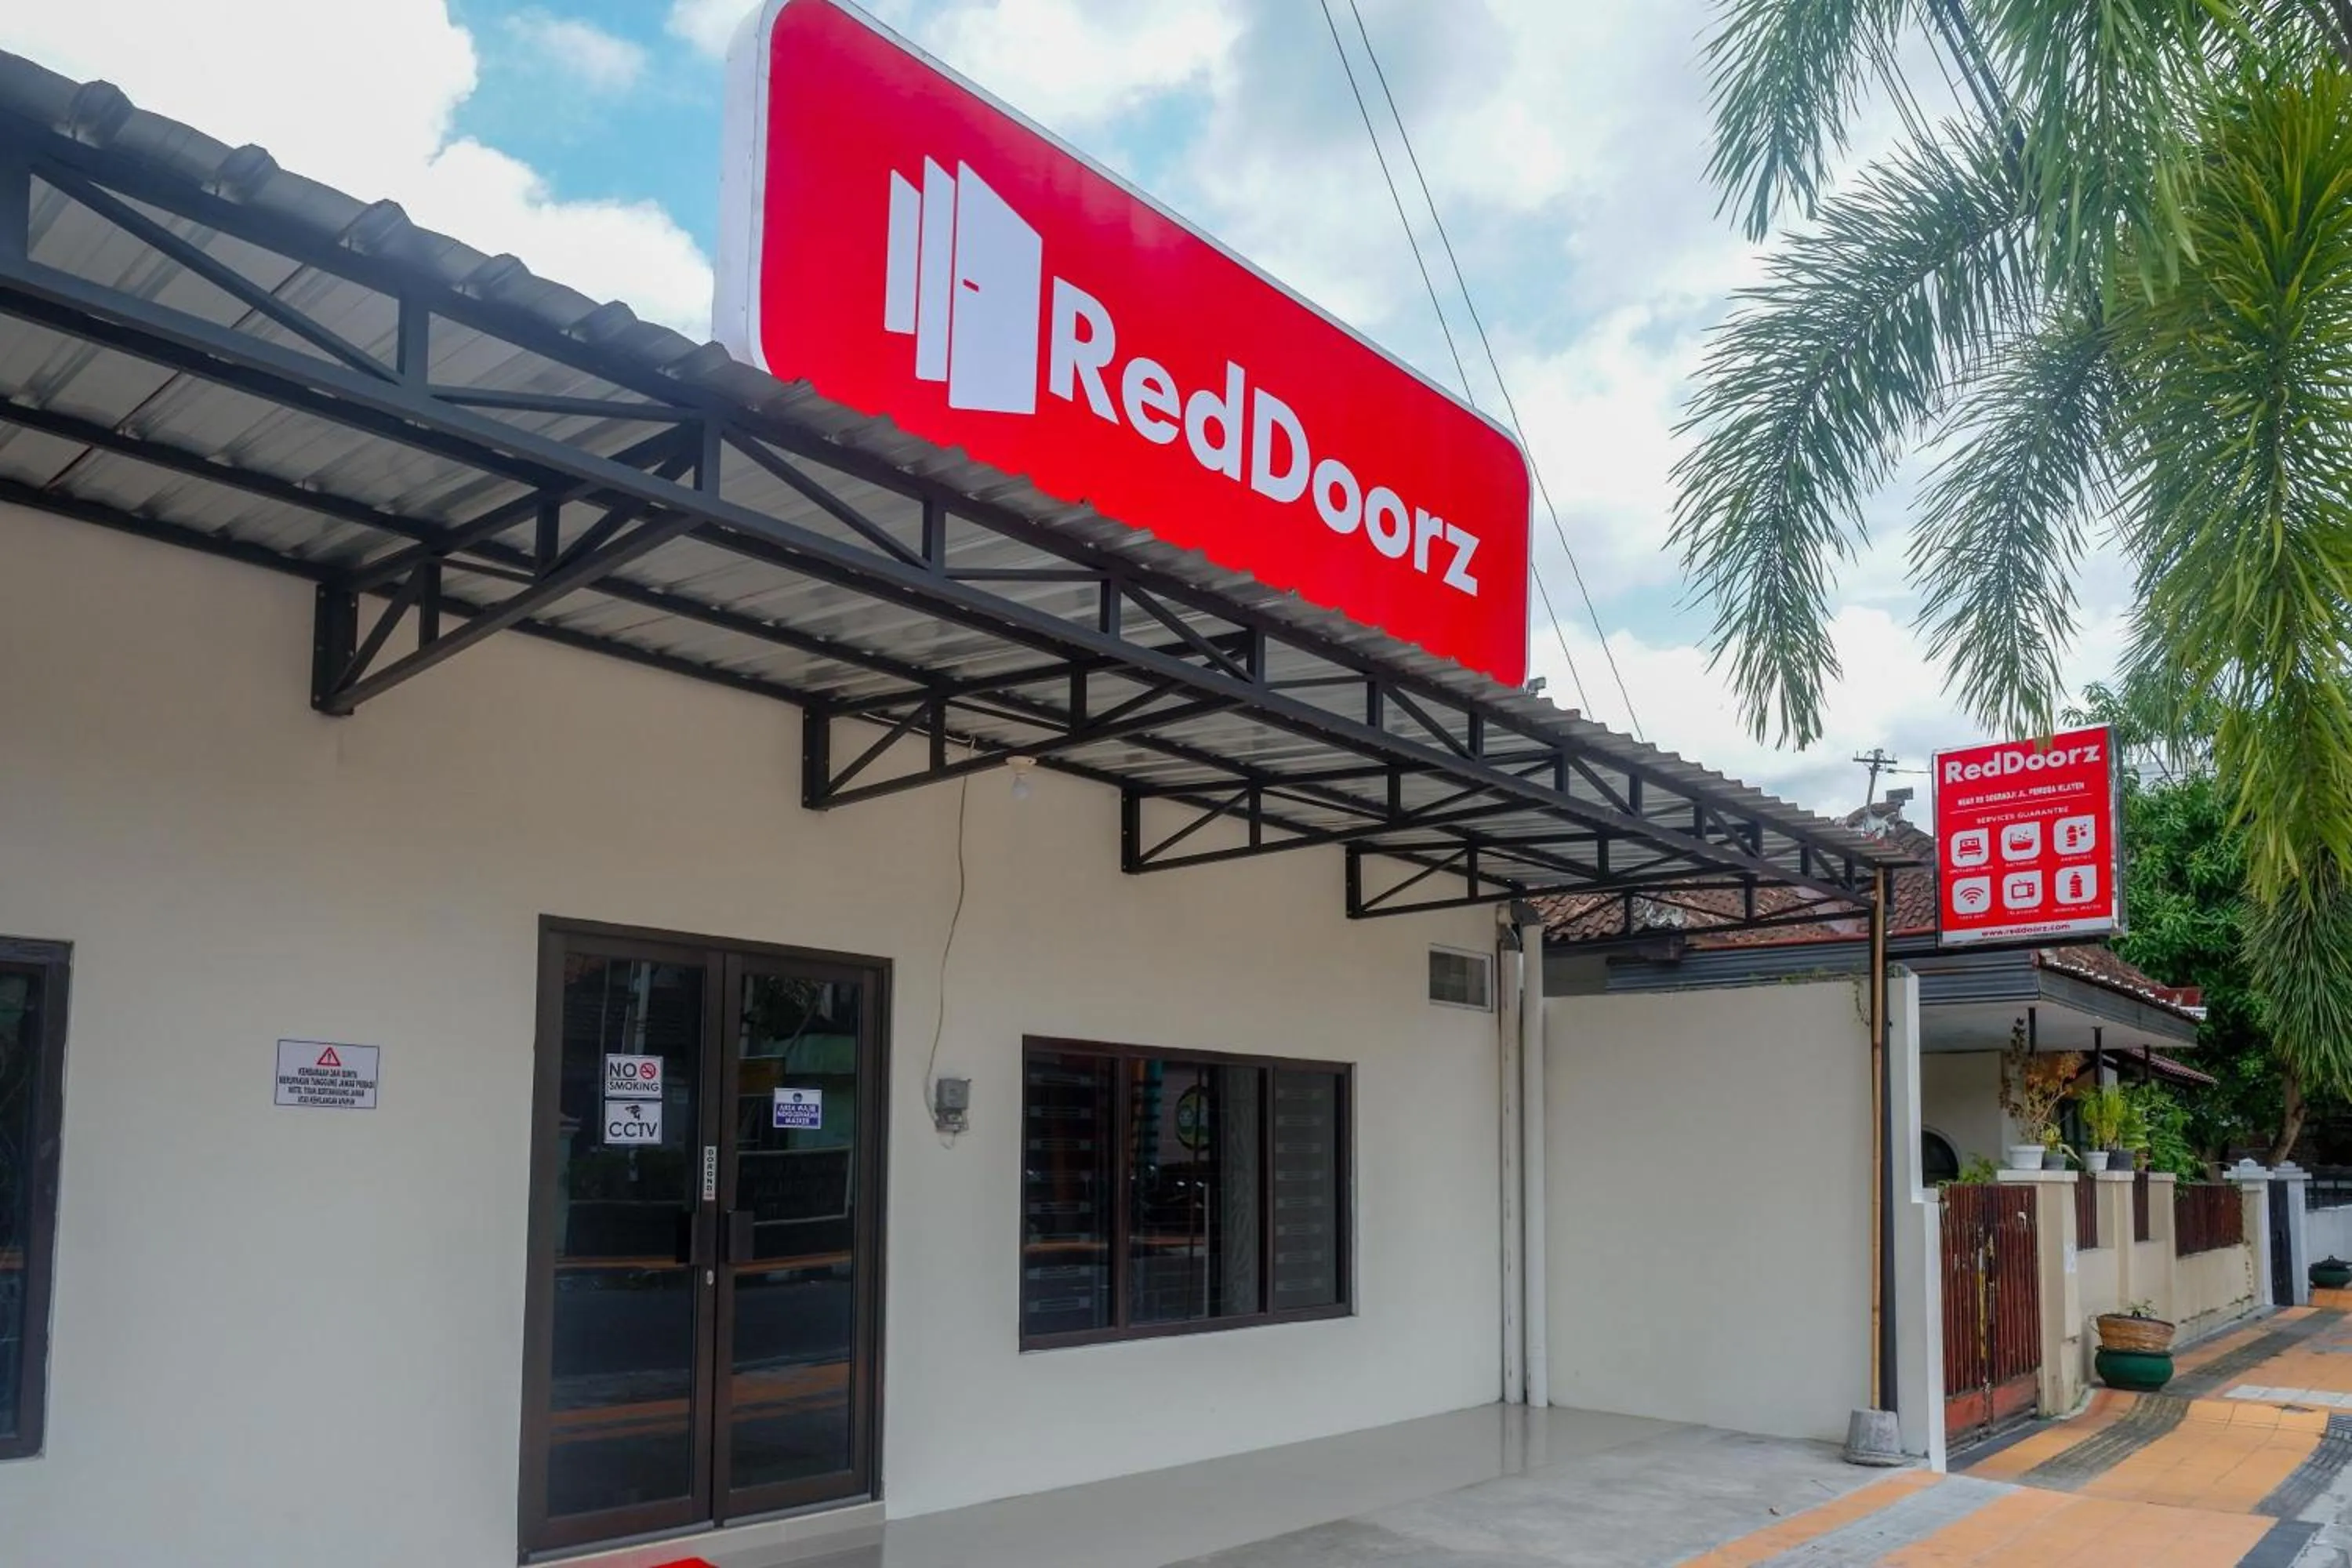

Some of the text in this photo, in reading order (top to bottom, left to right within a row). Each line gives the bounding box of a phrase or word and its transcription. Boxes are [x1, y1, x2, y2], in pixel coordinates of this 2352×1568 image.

[1049, 276, 1480, 597] RedDoorz
[1944, 745, 2100, 784] RedDoorz
[2057, 781, 2084, 792] KLATEN
[1976, 806, 2068, 824] SERVICES GUARANTEE
[1980, 924, 2071, 937] www.reddoorz.com
[609, 1062, 637, 1077] NO
[609, 1082, 659, 1091] SMOKING
[608, 1121, 658, 1137] CCTV
